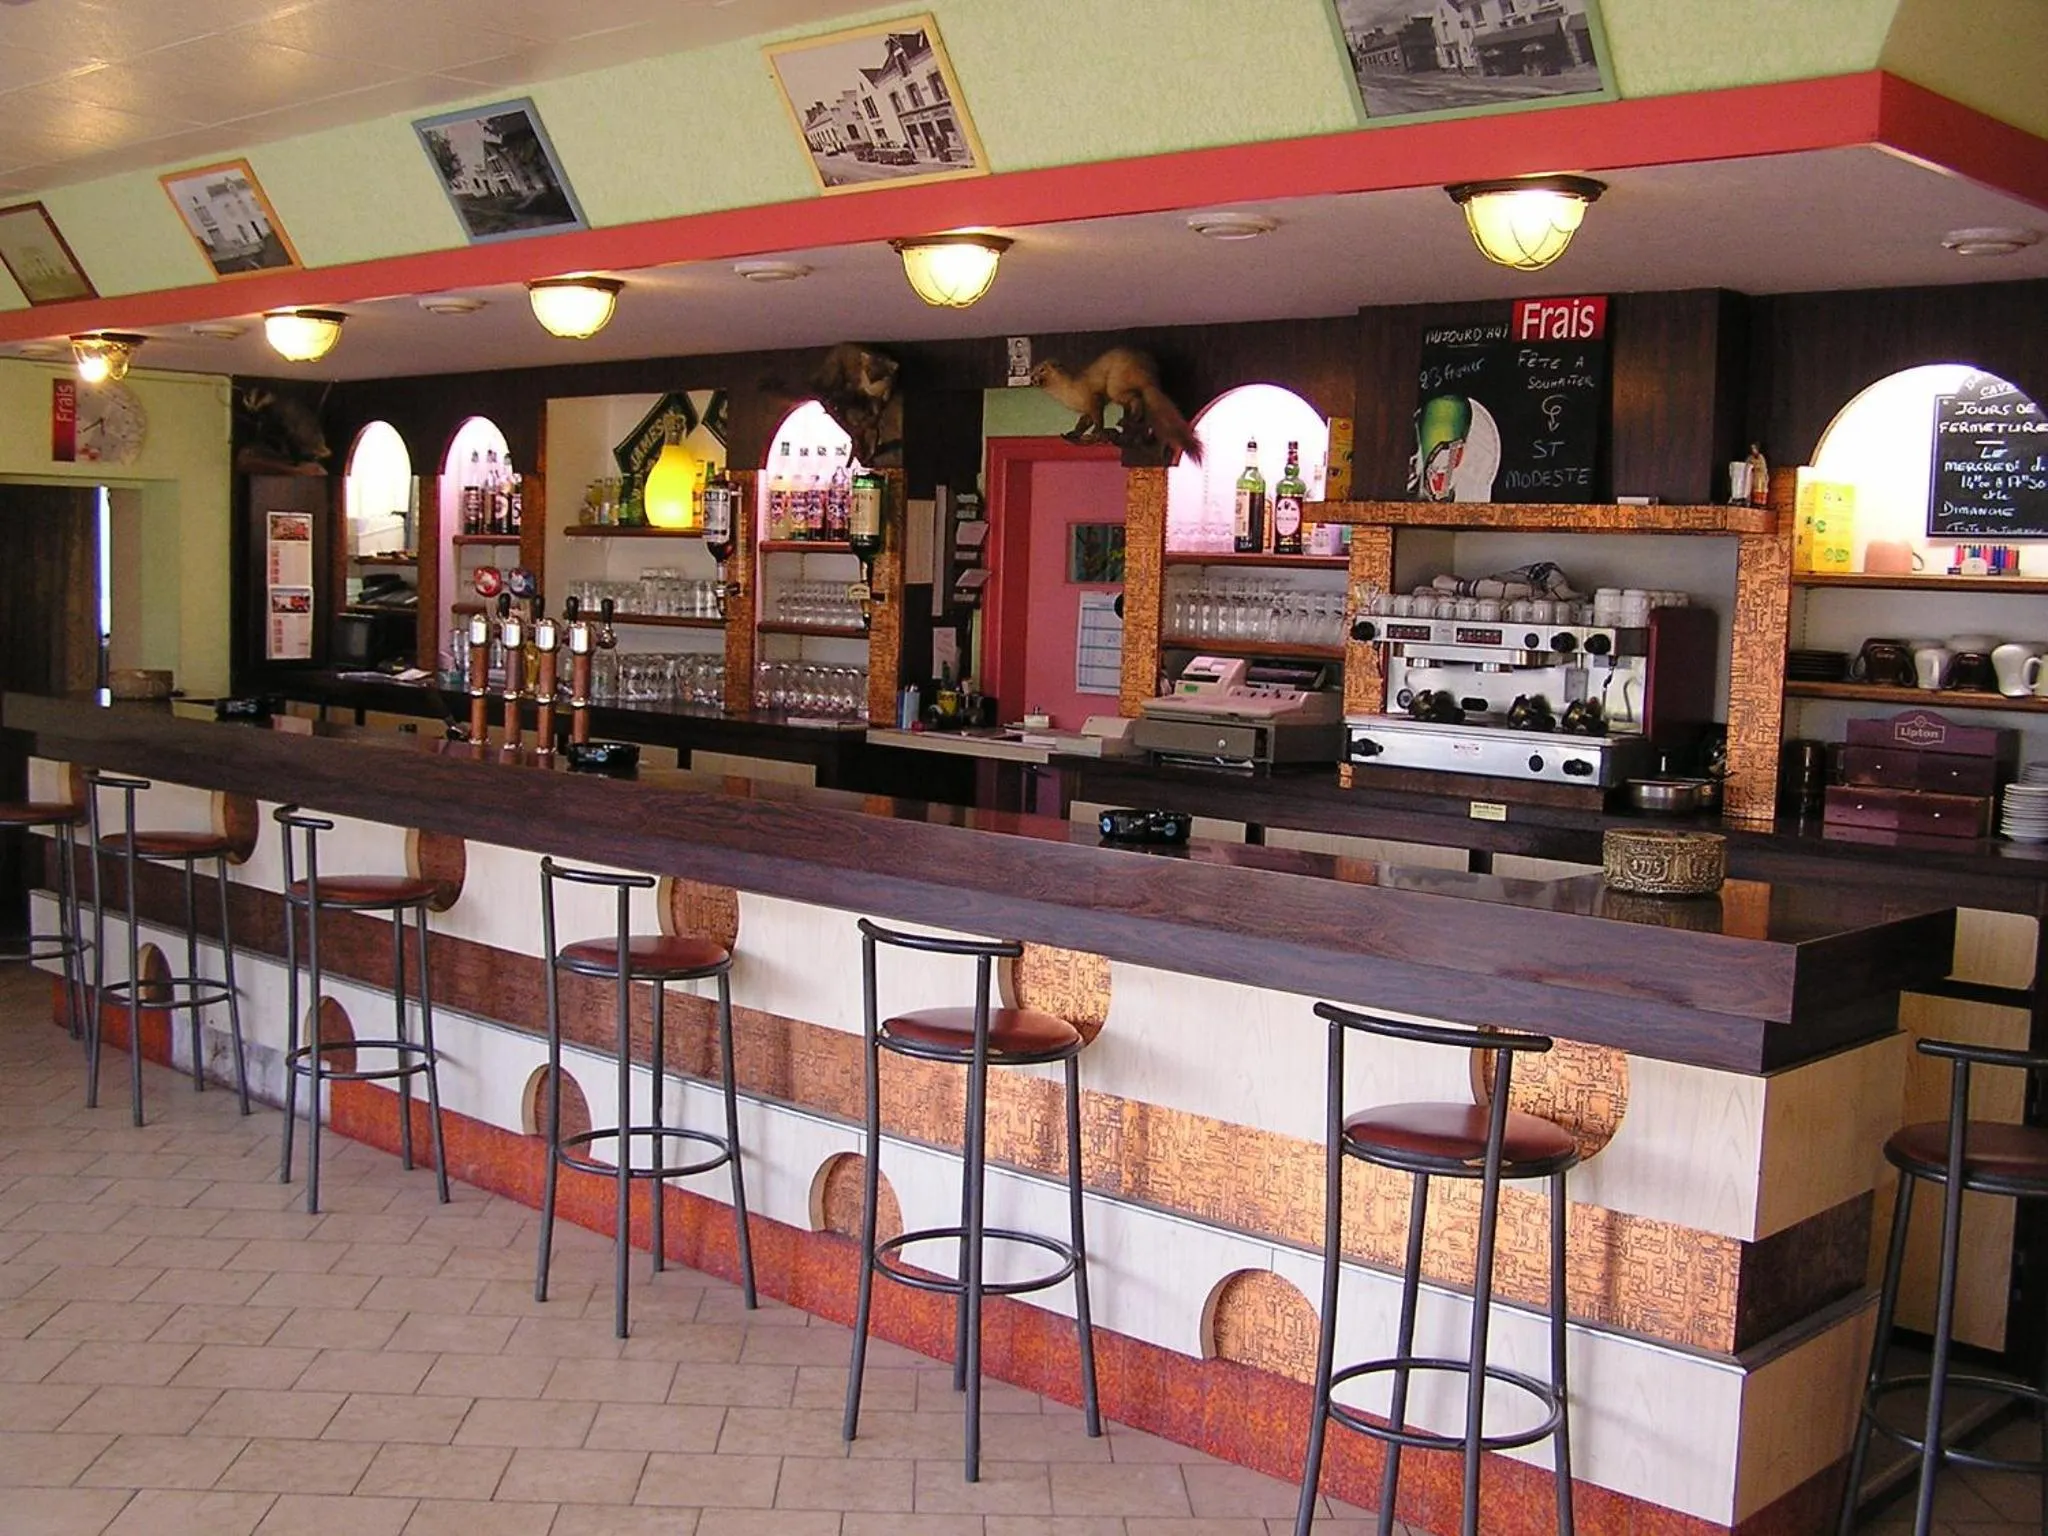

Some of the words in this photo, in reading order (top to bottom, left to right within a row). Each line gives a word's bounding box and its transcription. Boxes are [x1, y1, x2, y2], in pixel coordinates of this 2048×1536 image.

[1522, 300, 1595, 340] Frais
[56, 384, 73, 423] Frais
[1954, 402, 2012, 415] JOURS
[1939, 421, 2048, 434] FERMETURE
[1532, 441, 1565, 459] ST
[1505, 467, 1592, 489] MODESTE
[1901, 727, 1938, 738] Lipton
